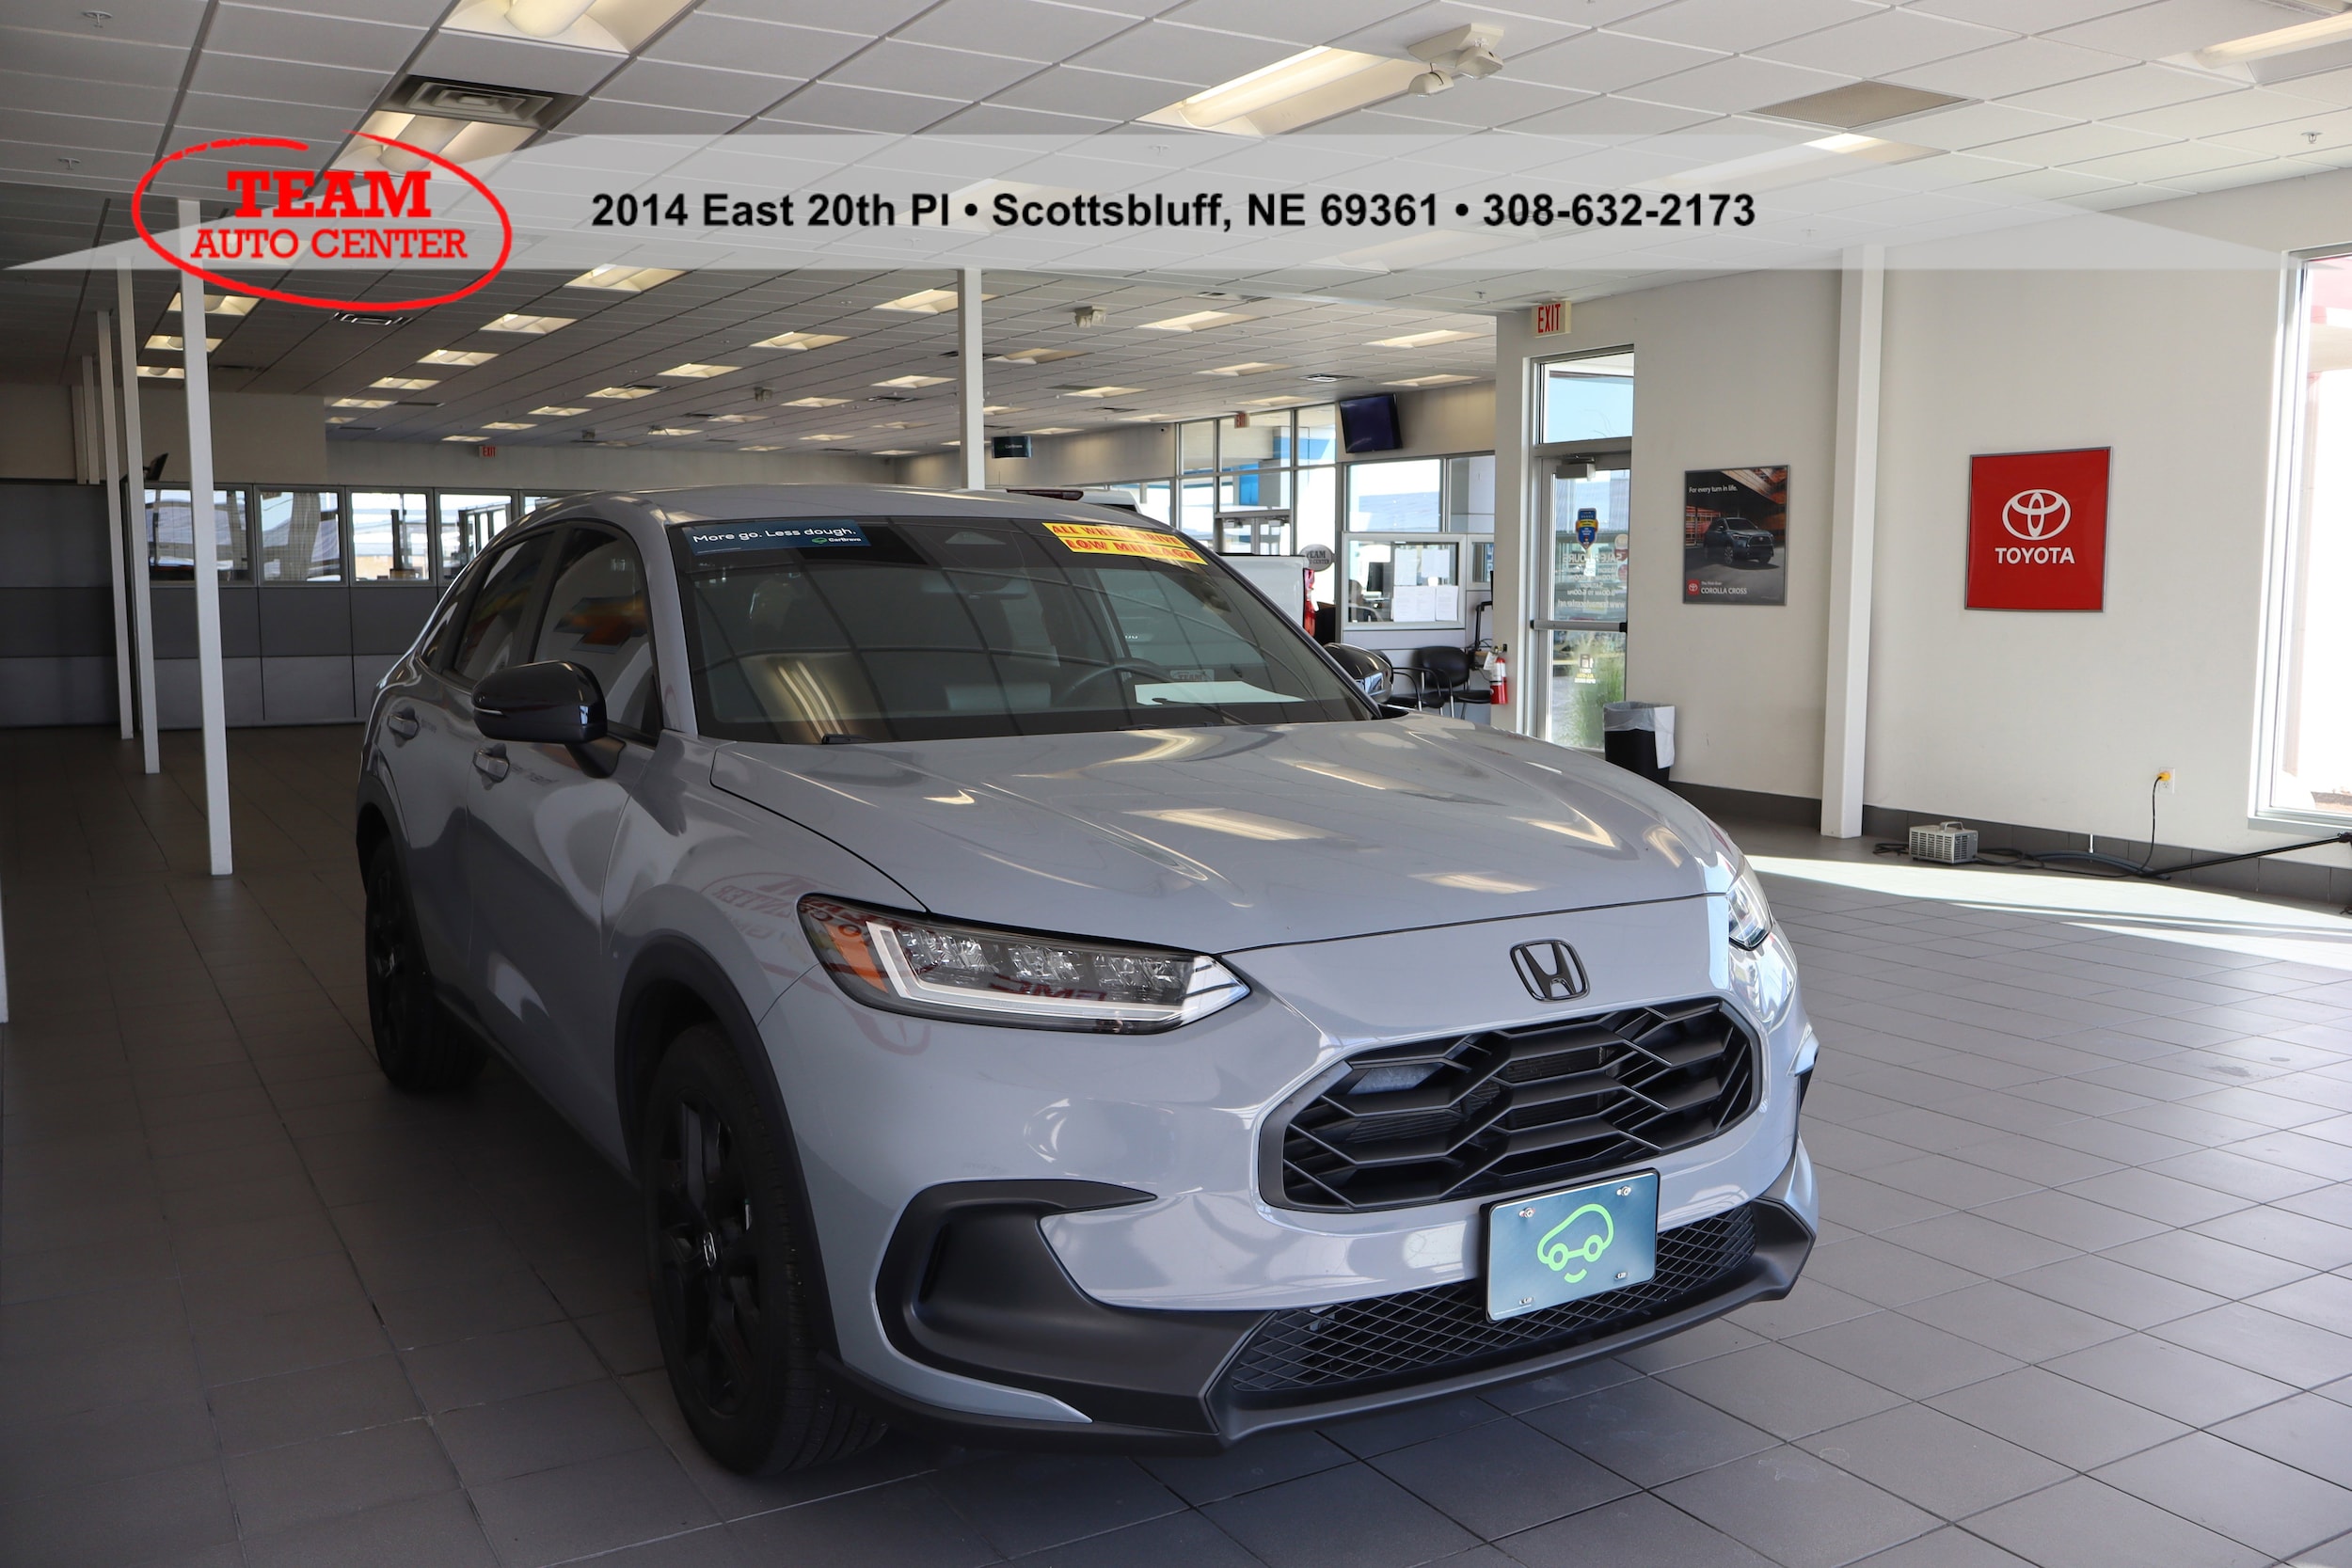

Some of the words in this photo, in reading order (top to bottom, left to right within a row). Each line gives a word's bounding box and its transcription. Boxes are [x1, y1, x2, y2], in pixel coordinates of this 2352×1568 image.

[1537, 303, 1561, 333] EXIT
[692, 533, 735, 543] More
[739, 531, 762, 541] go.
[765, 529, 800, 537] Less
[804, 527, 856, 537] dough.
[1053, 525, 1079, 534] ALL
[1082, 527, 1136, 542] WHEEL
[1136, 532, 1183, 546] DRIVE
[1065, 538, 1107, 549] LOW
[1114, 542, 1200, 560] MILEAGE
[1994, 546, 2075, 564] TOYOTA
